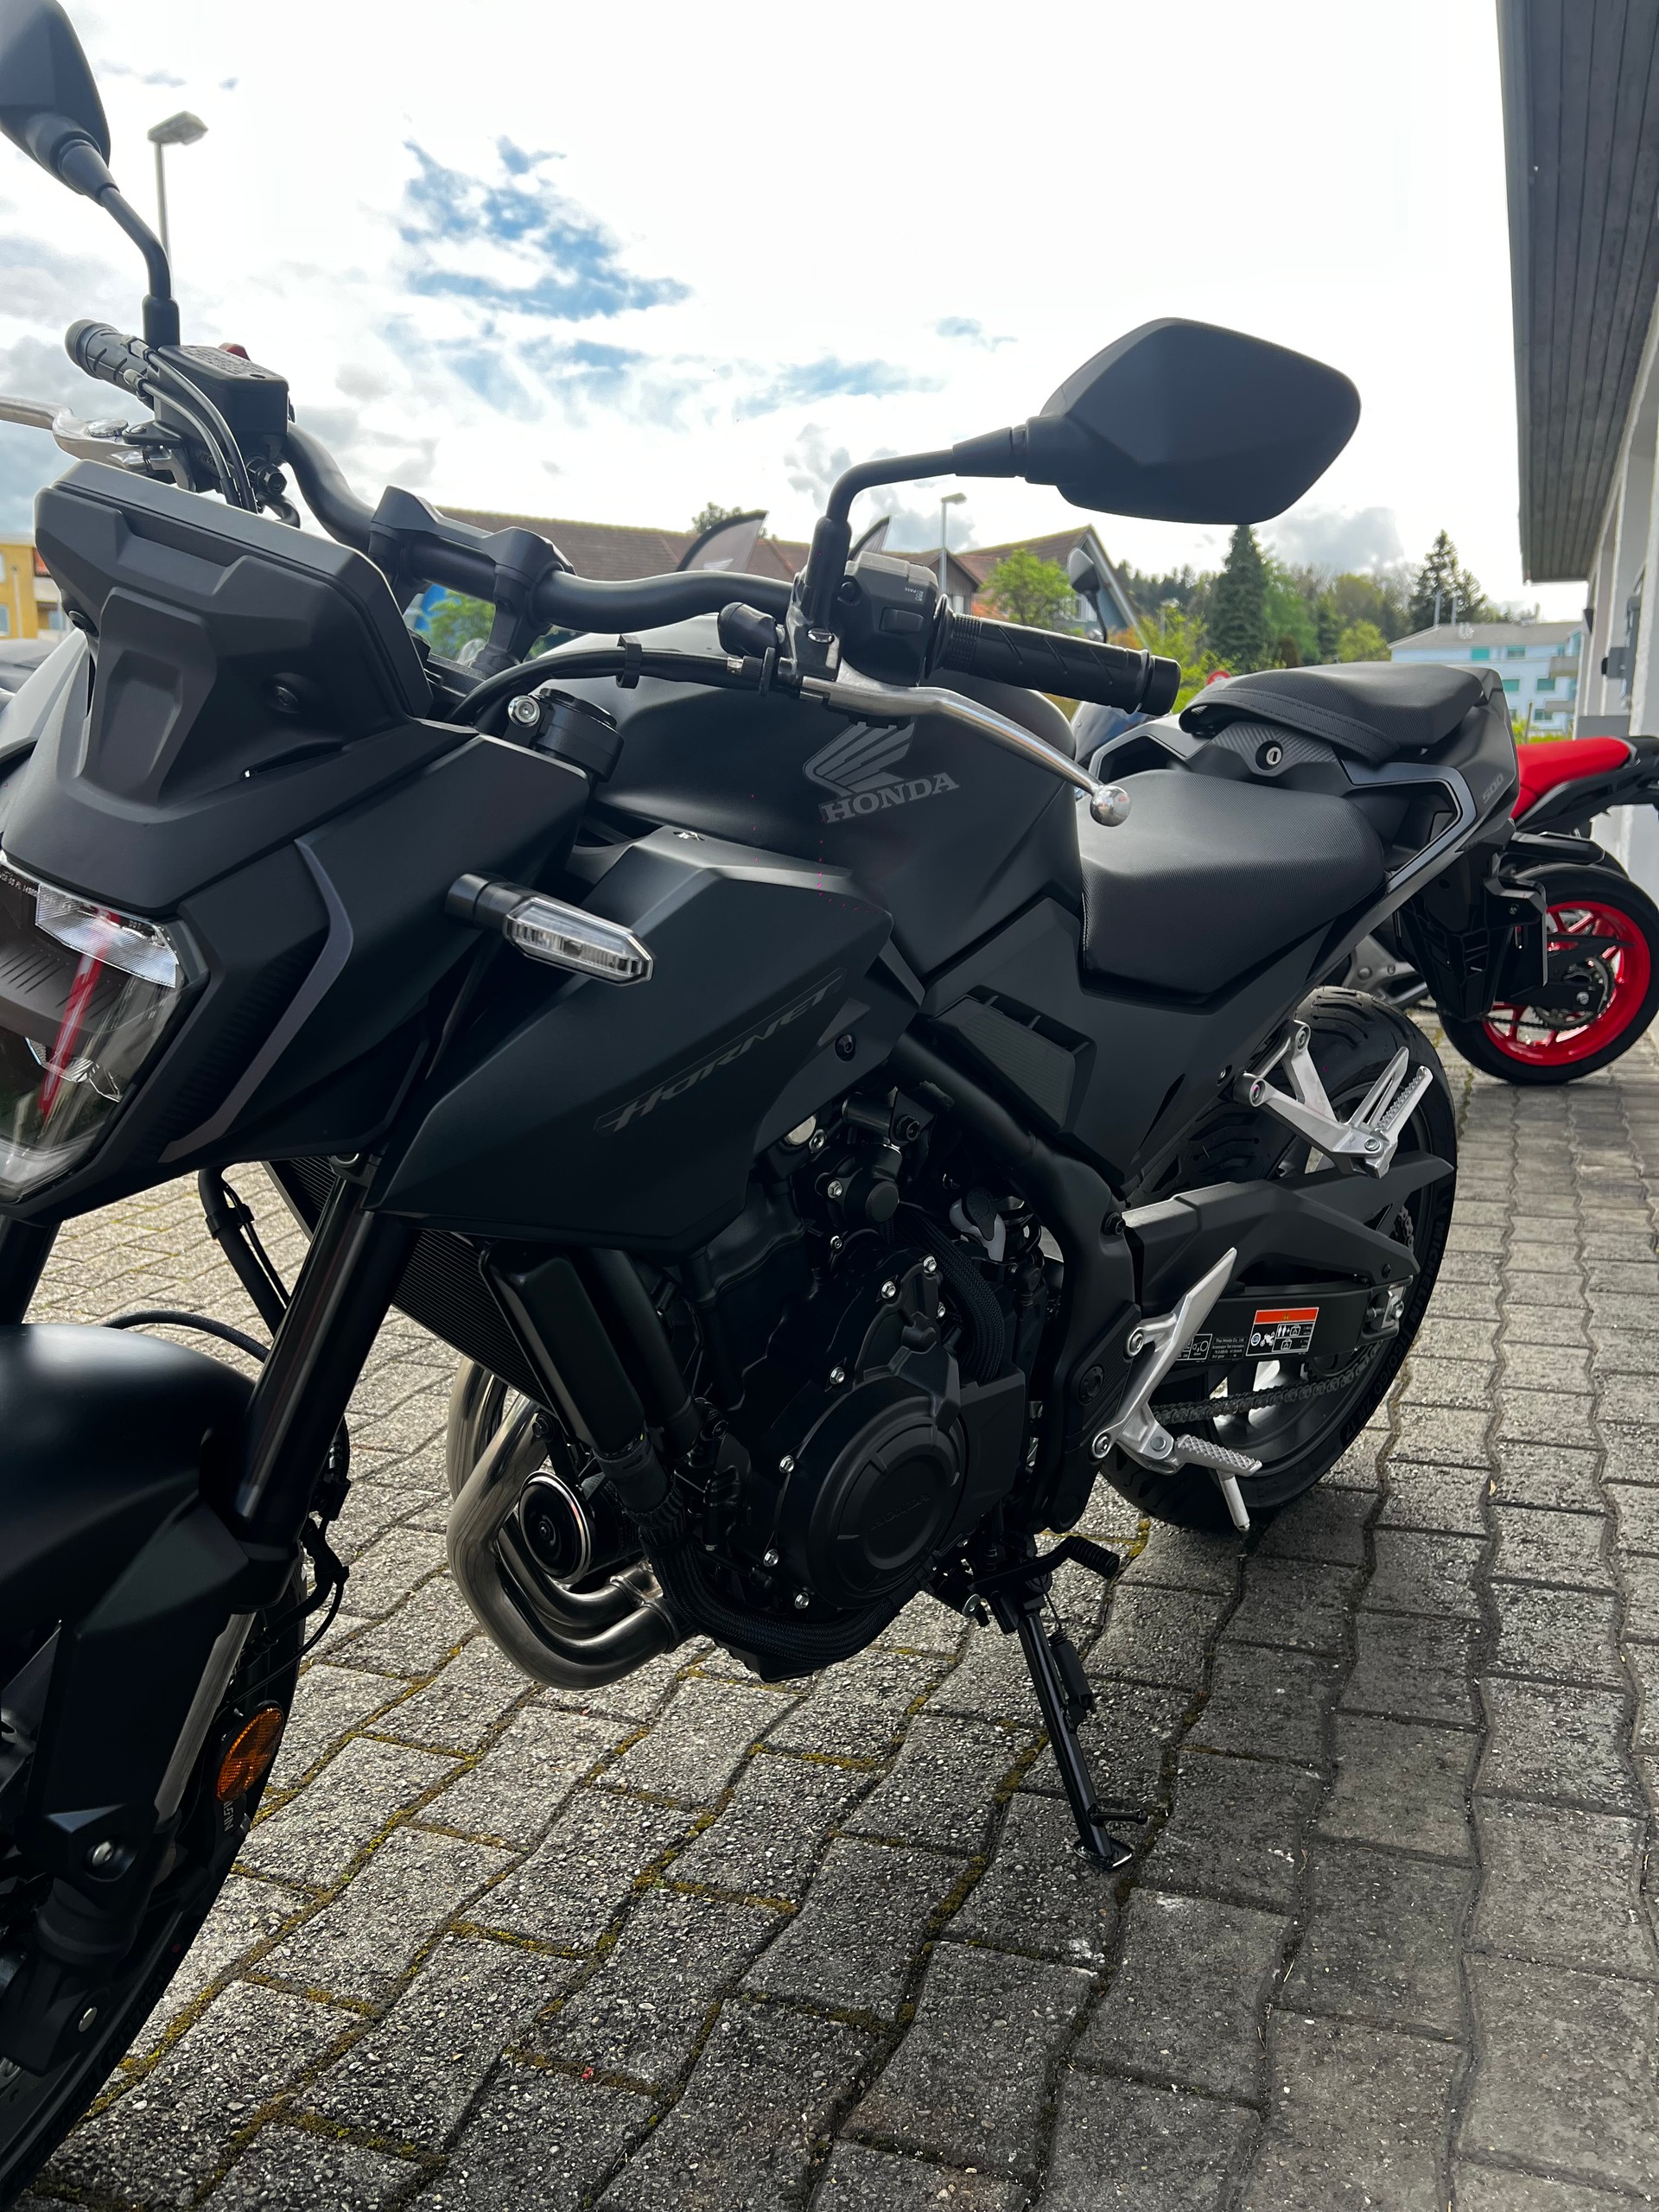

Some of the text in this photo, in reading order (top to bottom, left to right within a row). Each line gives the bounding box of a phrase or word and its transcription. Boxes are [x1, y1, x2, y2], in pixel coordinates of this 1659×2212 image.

[821, 771, 961, 824] HONDA
[1482, 772, 1504, 804] 500
[602, 974, 843, 1133] HORNET
[1408, 1220, 1446, 1323] MICHELIN
